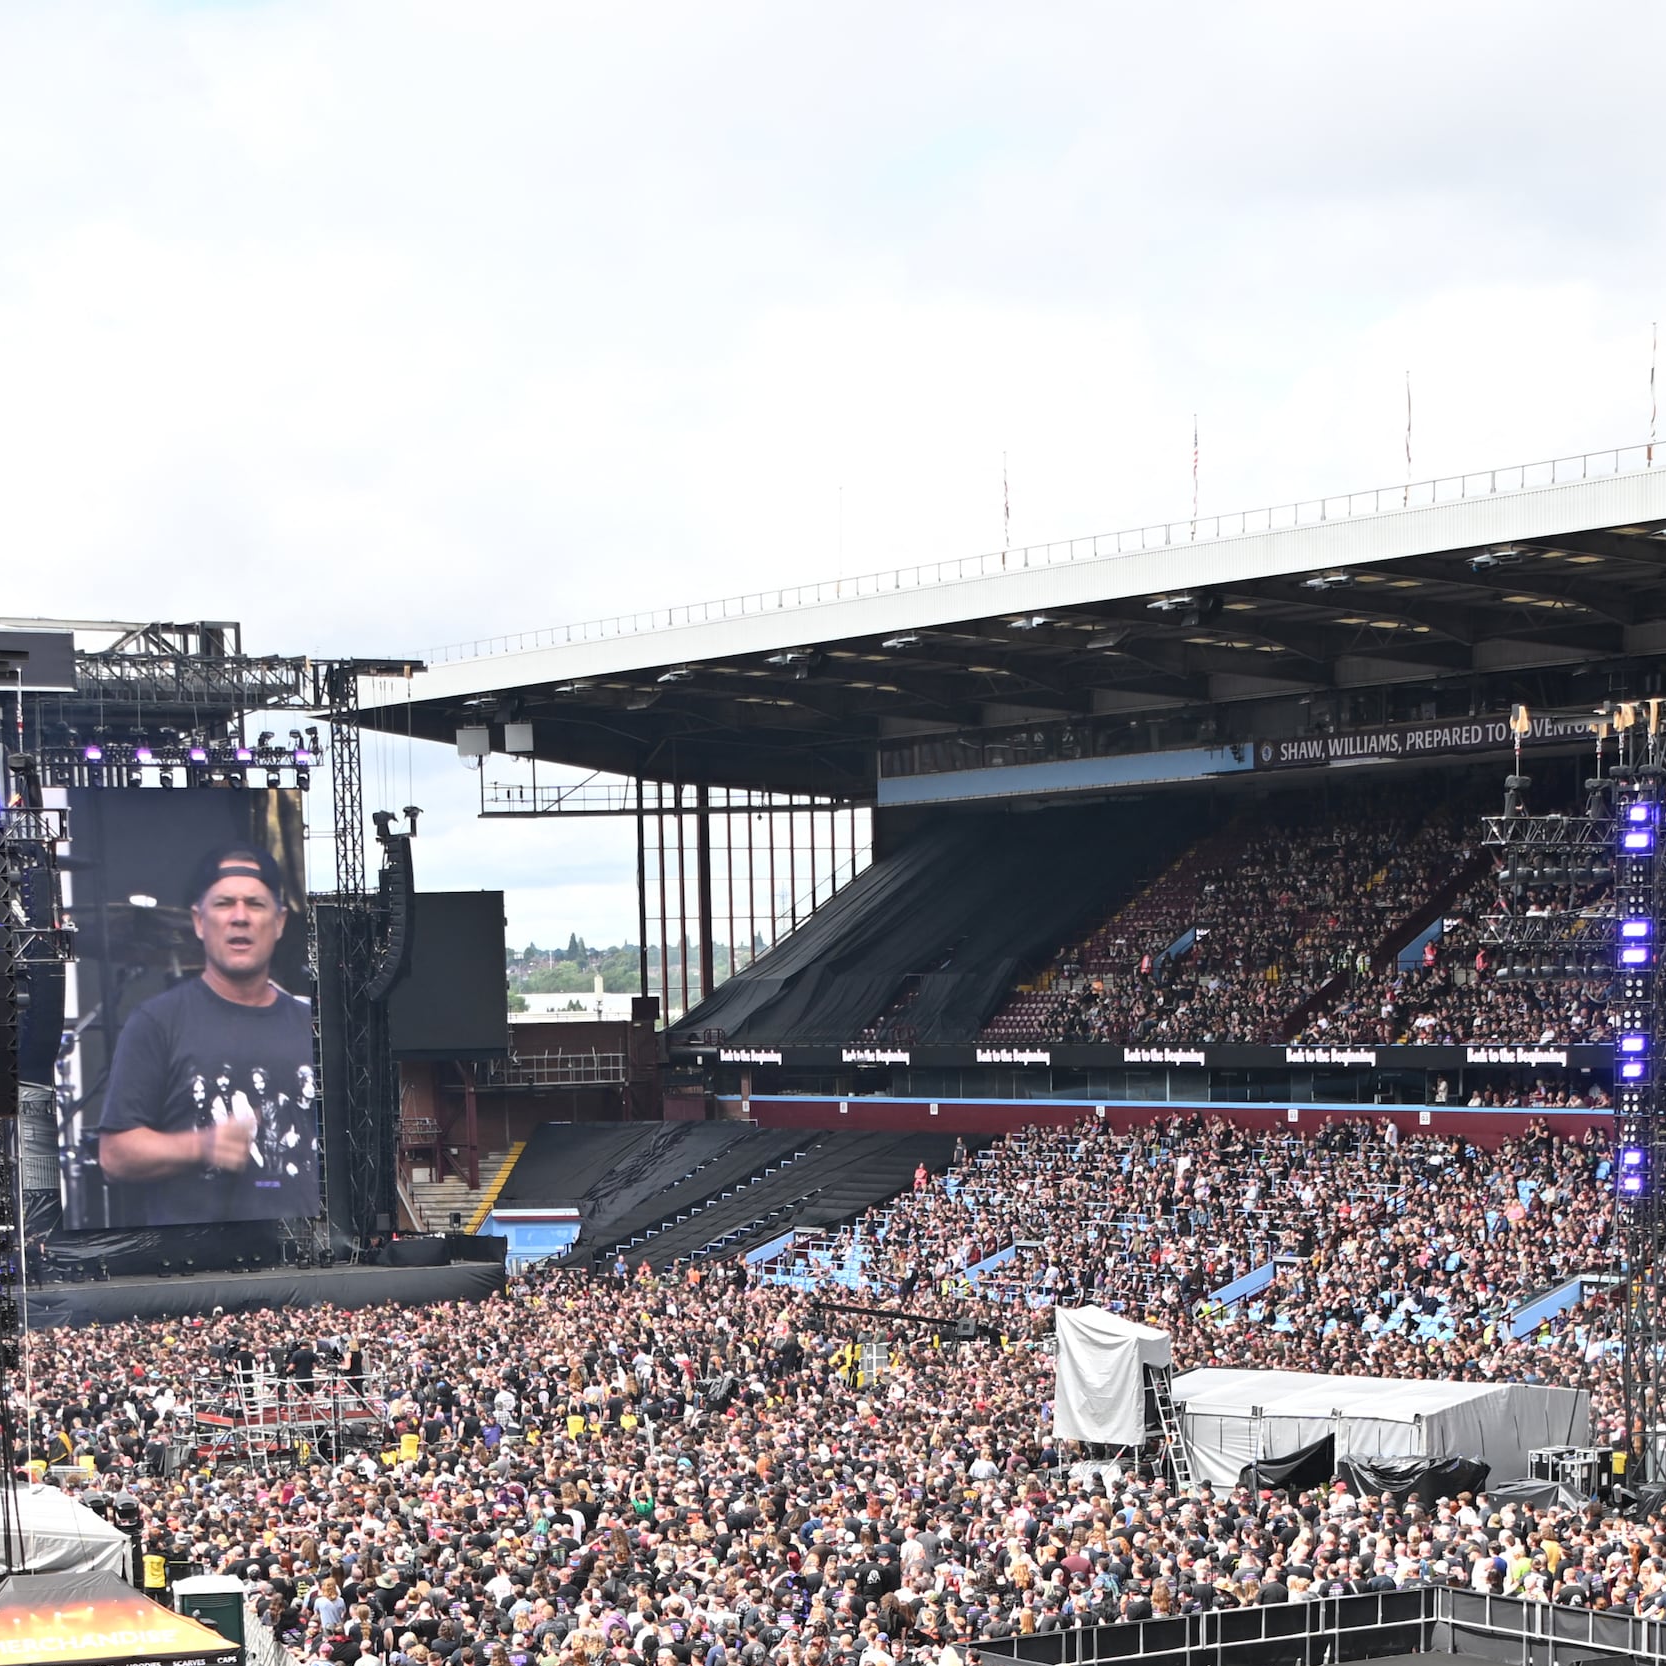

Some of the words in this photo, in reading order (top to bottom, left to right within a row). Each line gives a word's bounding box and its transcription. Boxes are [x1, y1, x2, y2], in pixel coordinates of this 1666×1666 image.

[1280, 740, 1326, 761] SHAW,
[1328, 733, 1402, 757] WILLIAMS,
[1406, 725, 1482, 750] PREPARED
[1485, 722, 1506, 742] TO
[1286, 1048, 1305, 1062] Back
[1305, 1049, 1314, 1062] to
[1315, 1048, 1330, 1062] the
[1330, 1048, 1376, 1067] Beginning
[1467, 1047, 1488, 1063] Back
[1488, 1048, 1498, 1063] to
[1499, 1047, 1515, 1063] the
[1516, 1047, 1567, 1067] Beginning
[217, 1655, 238, 1665] CAPS
